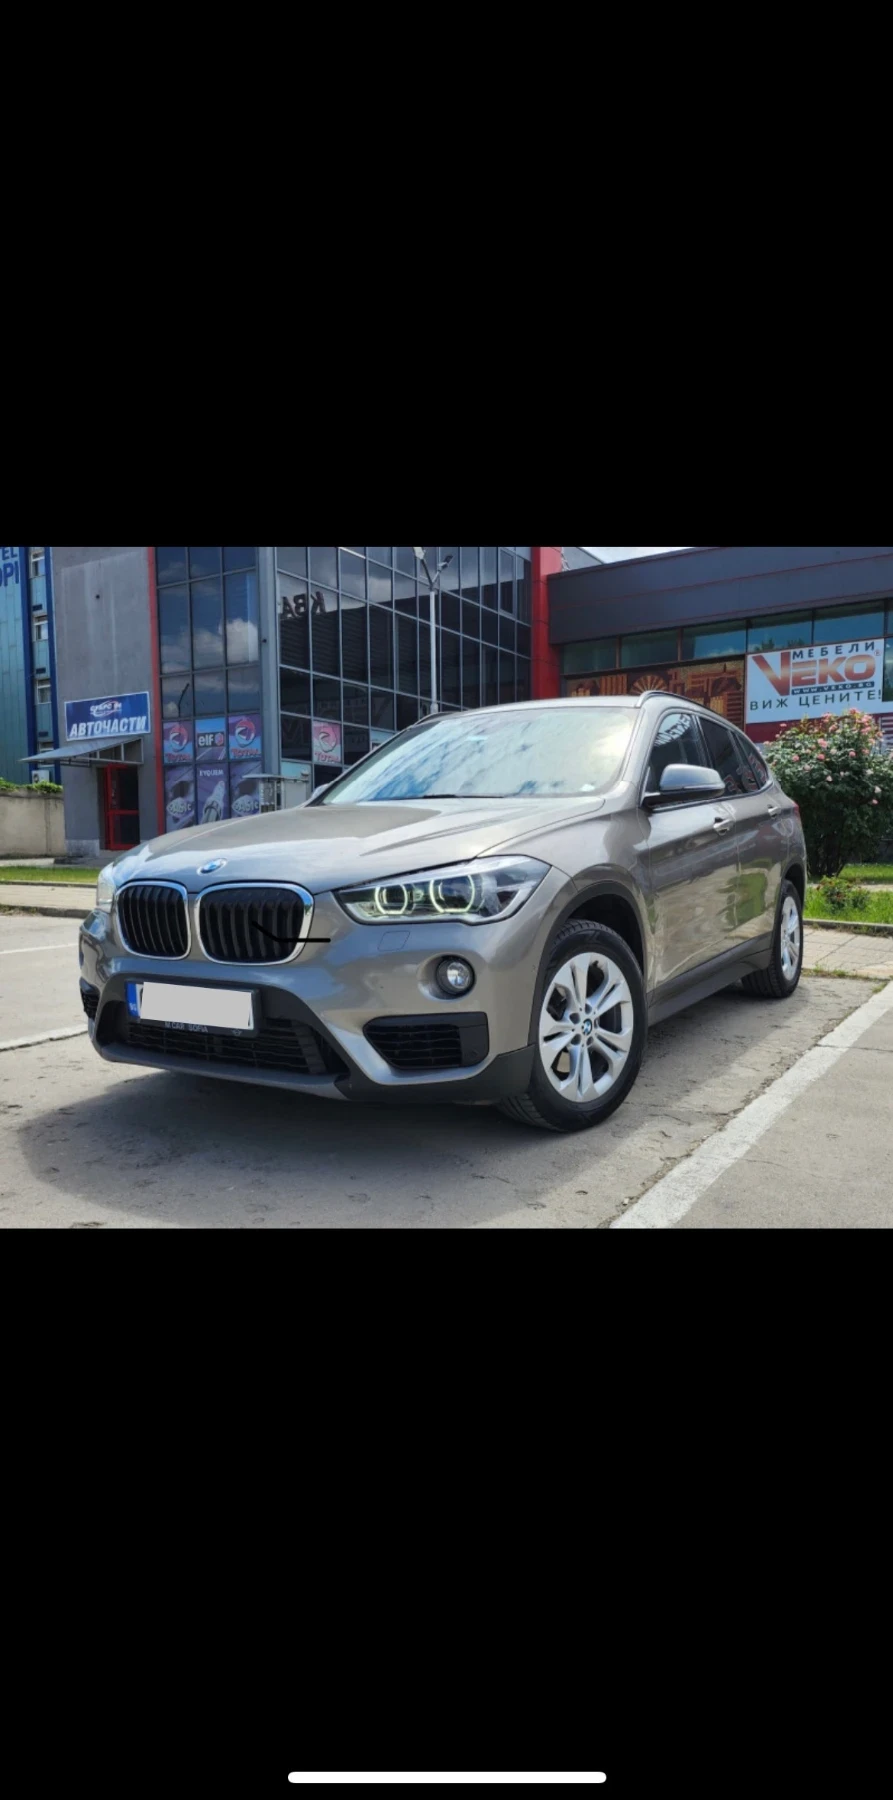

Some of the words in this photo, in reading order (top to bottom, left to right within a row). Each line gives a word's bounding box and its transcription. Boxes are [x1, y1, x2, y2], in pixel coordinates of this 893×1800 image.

[792, 641, 875, 660] МЕБЕЛИ
[752, 651, 876, 696] VEKO
[750, 698, 788, 711] ВИЖ
[799, 689, 882, 708] ЦЕНИТЕ!
[69, 716, 147, 737] АВТОЧАСТИ
[198, 734, 214, 746] elf
